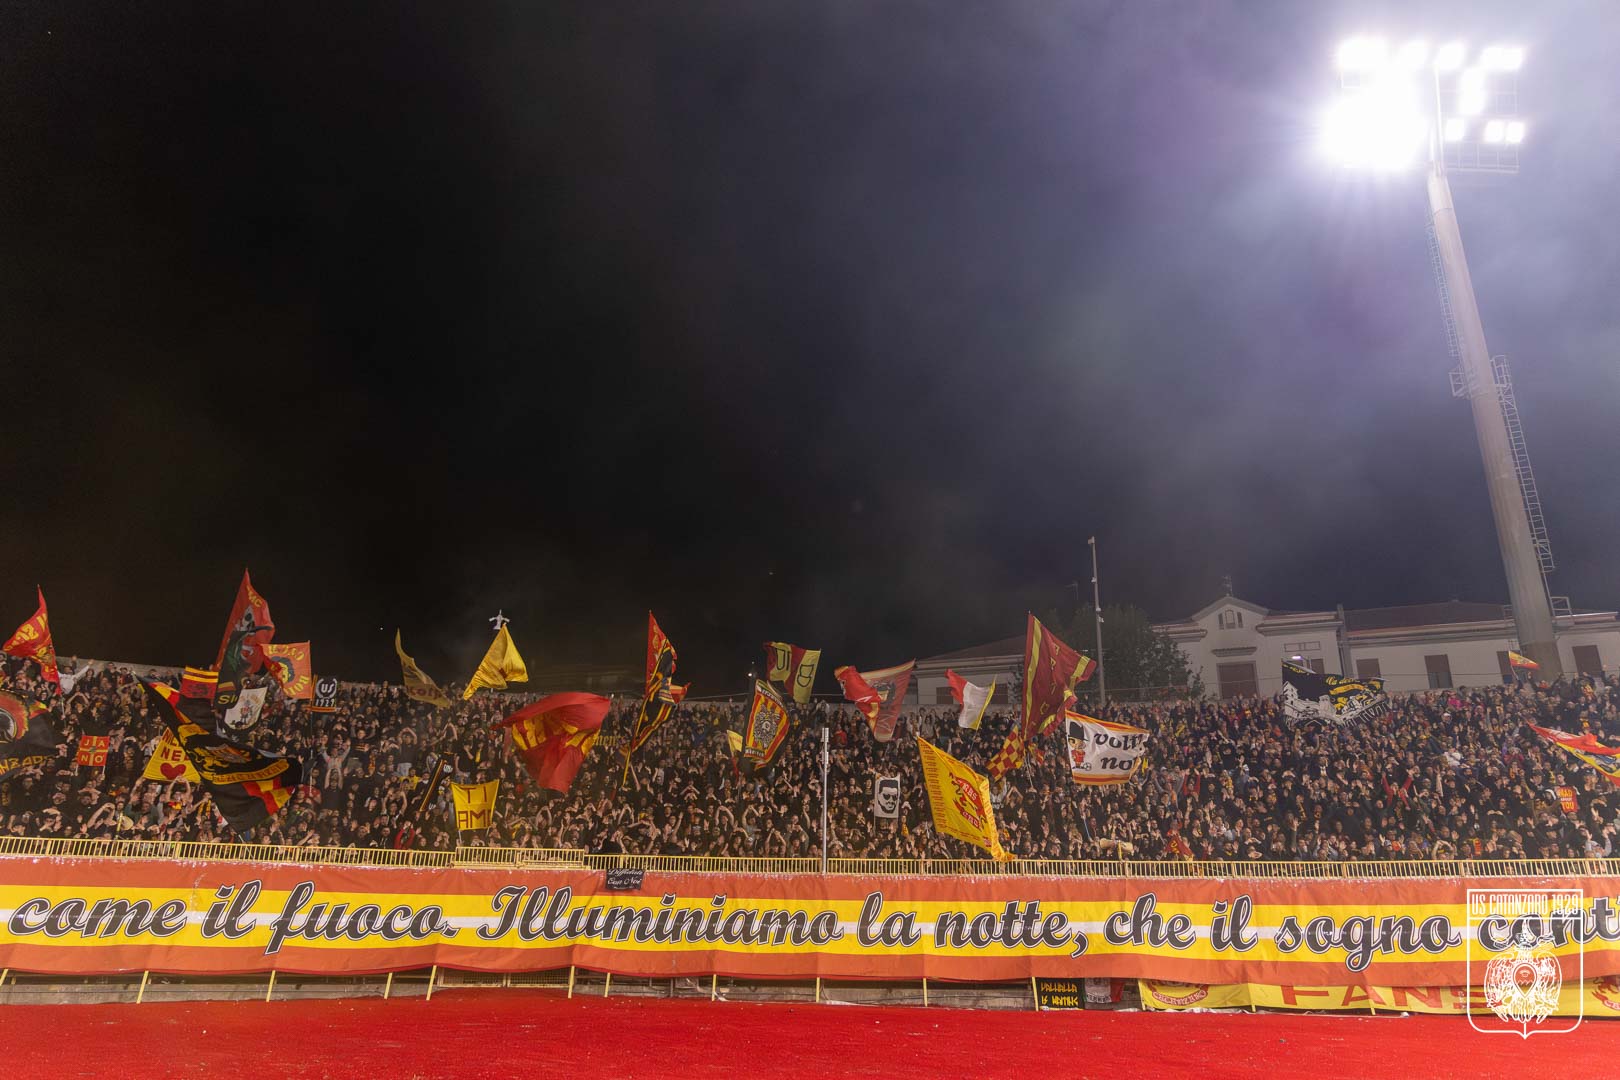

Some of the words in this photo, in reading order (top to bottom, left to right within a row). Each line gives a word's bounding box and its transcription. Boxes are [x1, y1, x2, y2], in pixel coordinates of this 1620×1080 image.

[320, 683, 335, 693] US
[460, 785, 487, 804] TI
[8, 897, 188, 938] come
[201, 879, 262, 939] il
[476, 885, 843, 946] Illuminiamo
[856, 891, 921, 948] la
[934, 899, 1089, 959] notte,
[1104, 891, 1196, 949] che
[1209, 894, 1257, 952] il
[1276, 913, 1461, 972] sogno
[1477, 894, 1620, 952] cont
